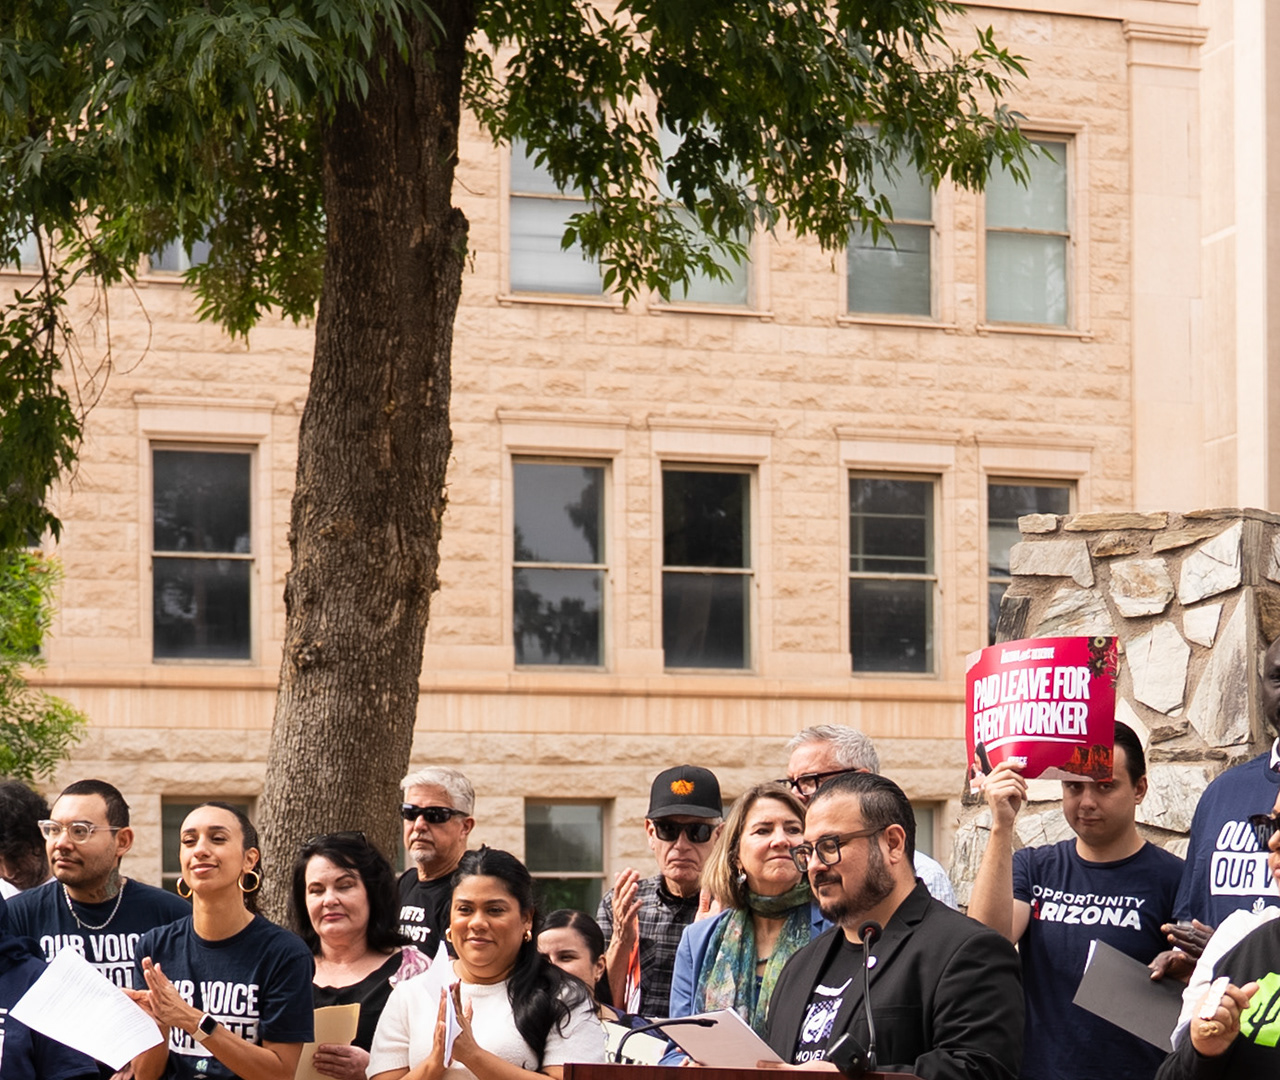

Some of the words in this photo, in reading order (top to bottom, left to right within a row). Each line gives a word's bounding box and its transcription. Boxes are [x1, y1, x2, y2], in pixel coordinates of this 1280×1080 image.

[973, 673, 1001, 713] PAID
[1000, 666, 1053, 704] LEAVE
[1053, 665, 1091, 700] FOR
[973, 704, 1009, 747] EVERY
[1008, 701, 1088, 735] WORKER
[1214, 857, 1257, 889] OUR
[1032, 884, 1145, 908] OPPORTUNITY
[89, 933, 144, 962] VOIC
[200, 980, 260, 1017] VOICE
